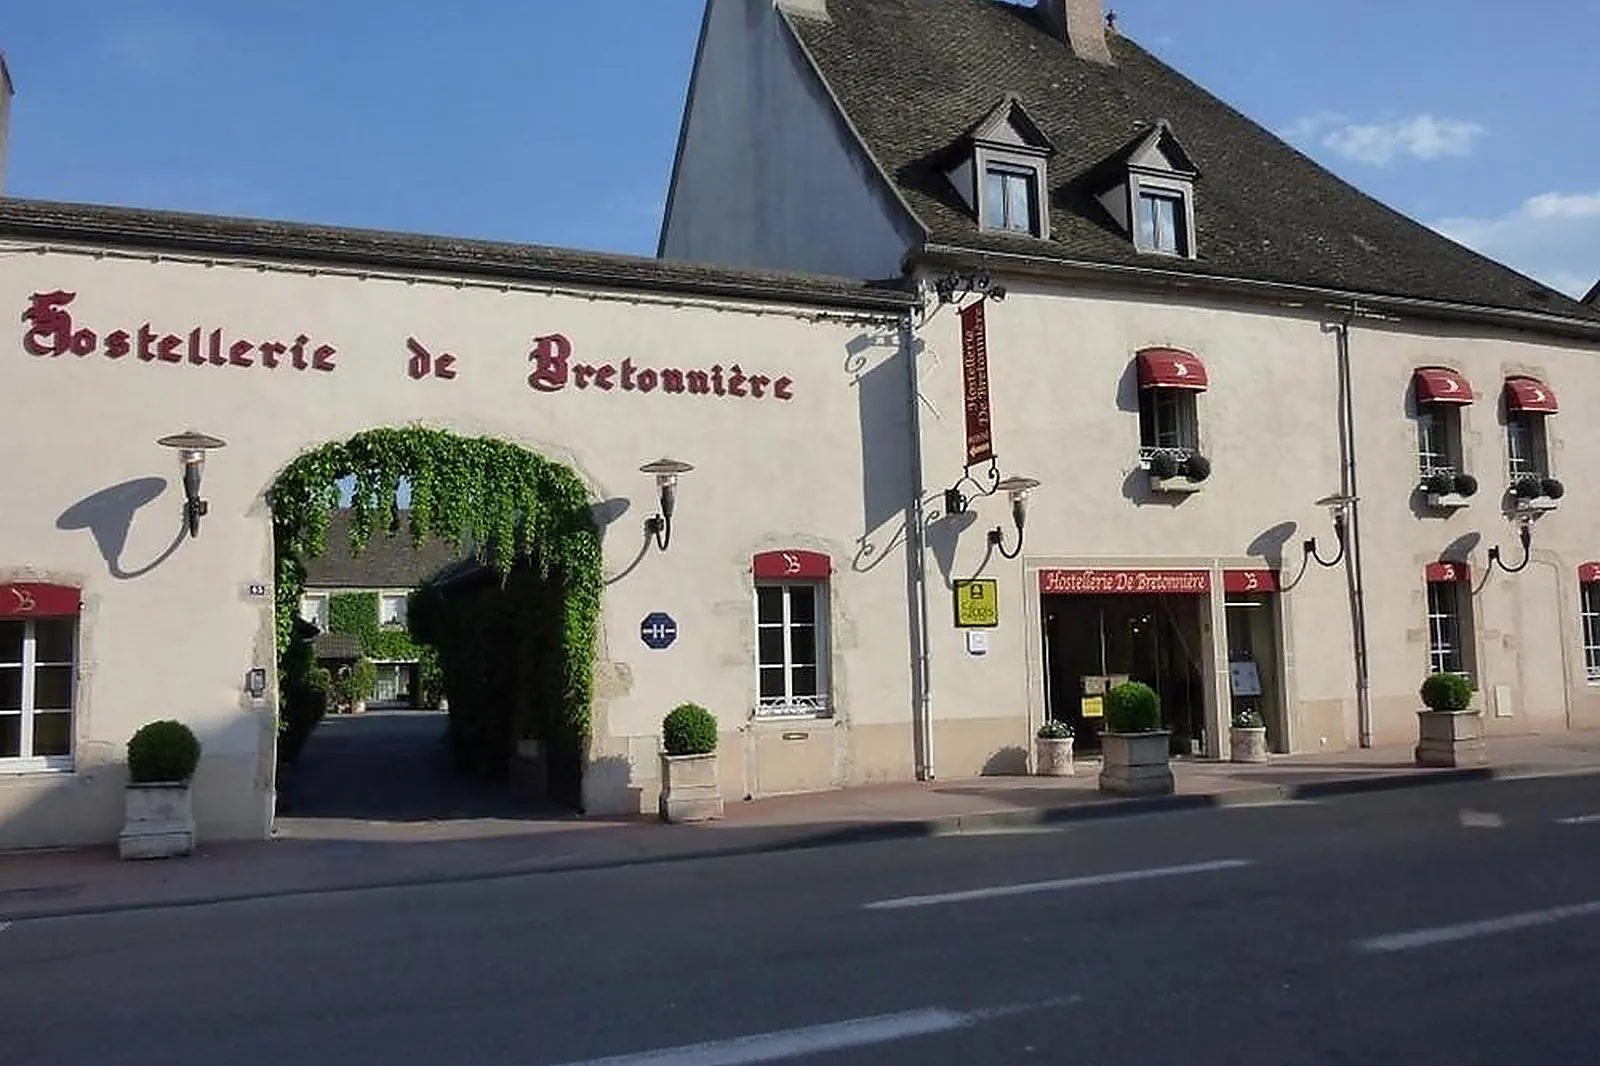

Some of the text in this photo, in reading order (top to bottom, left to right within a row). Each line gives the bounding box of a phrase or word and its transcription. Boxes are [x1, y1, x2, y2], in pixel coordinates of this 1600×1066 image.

[21, 290, 795, 401] Hostellerie de Bretonnière
[1114, 573, 1134, 590] De
